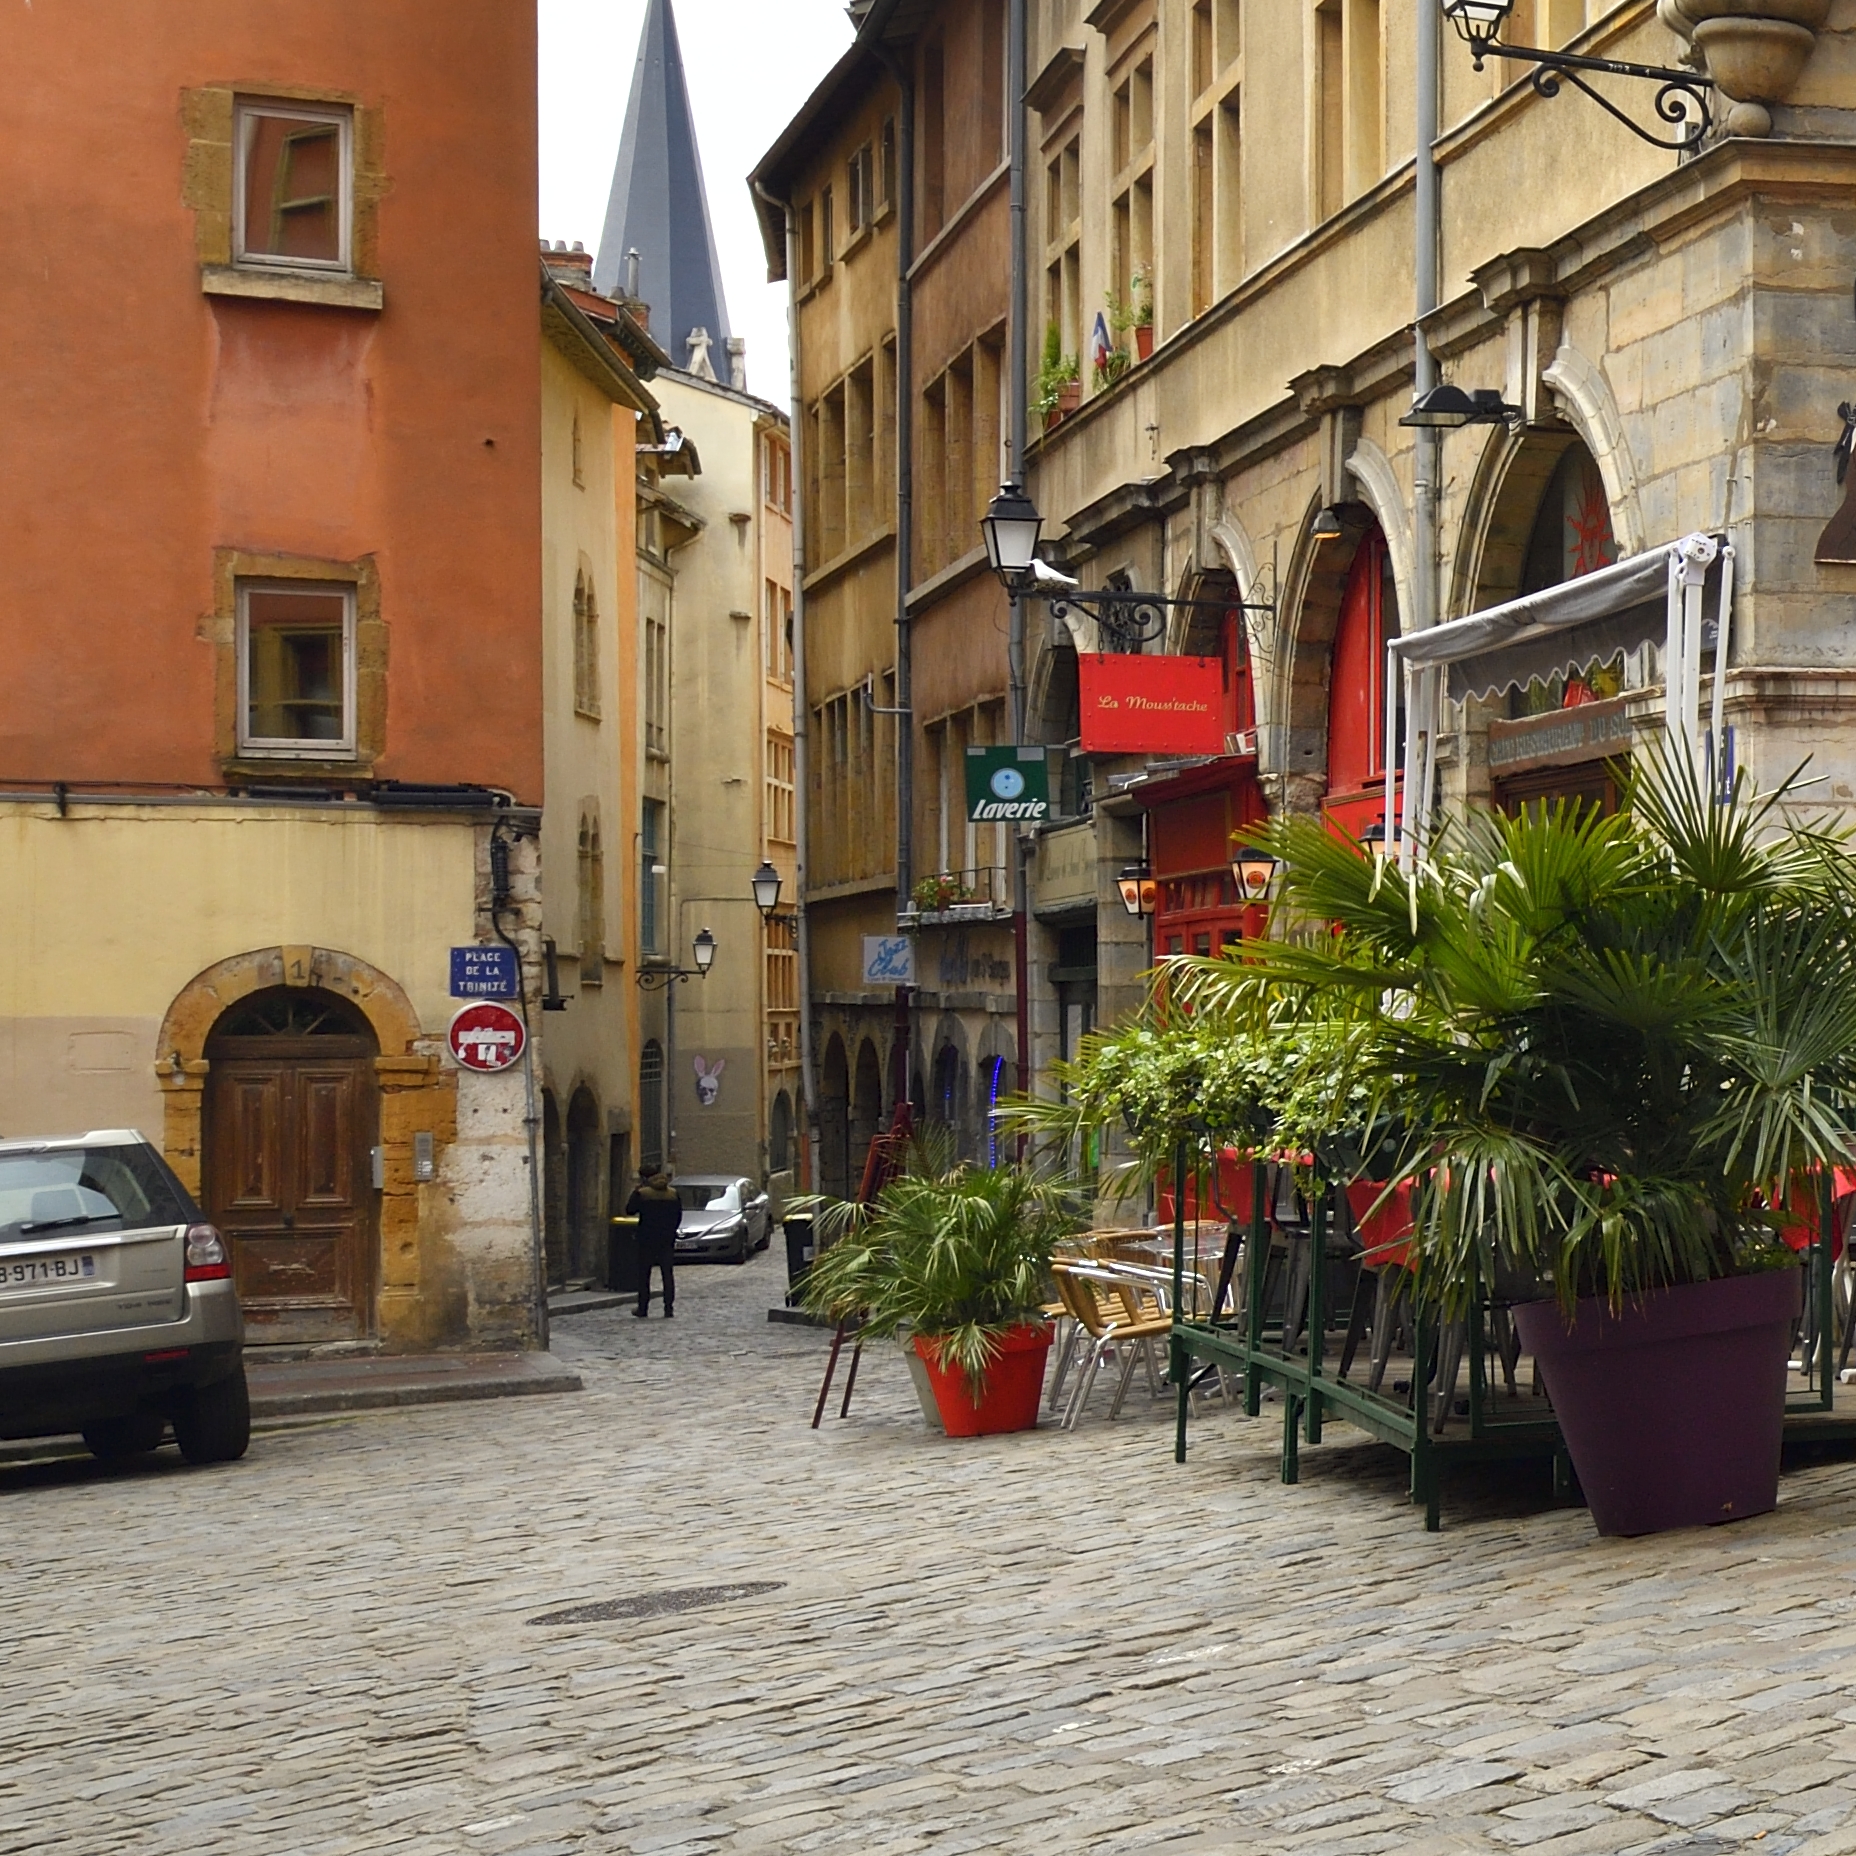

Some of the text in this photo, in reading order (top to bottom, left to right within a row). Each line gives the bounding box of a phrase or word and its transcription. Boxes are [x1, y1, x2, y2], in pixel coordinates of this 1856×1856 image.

[1097, 695, 1208, 712] La Mouss'tache
[972, 797, 1047, 820] Laverie
[465, 952, 502, 962] PLACE
[878, 938, 909, 961] Jazz
[465, 966, 500, 976] DE LA
[867, 956, 910, 977] Club
[458, 980, 508, 993] TRINITÉ
